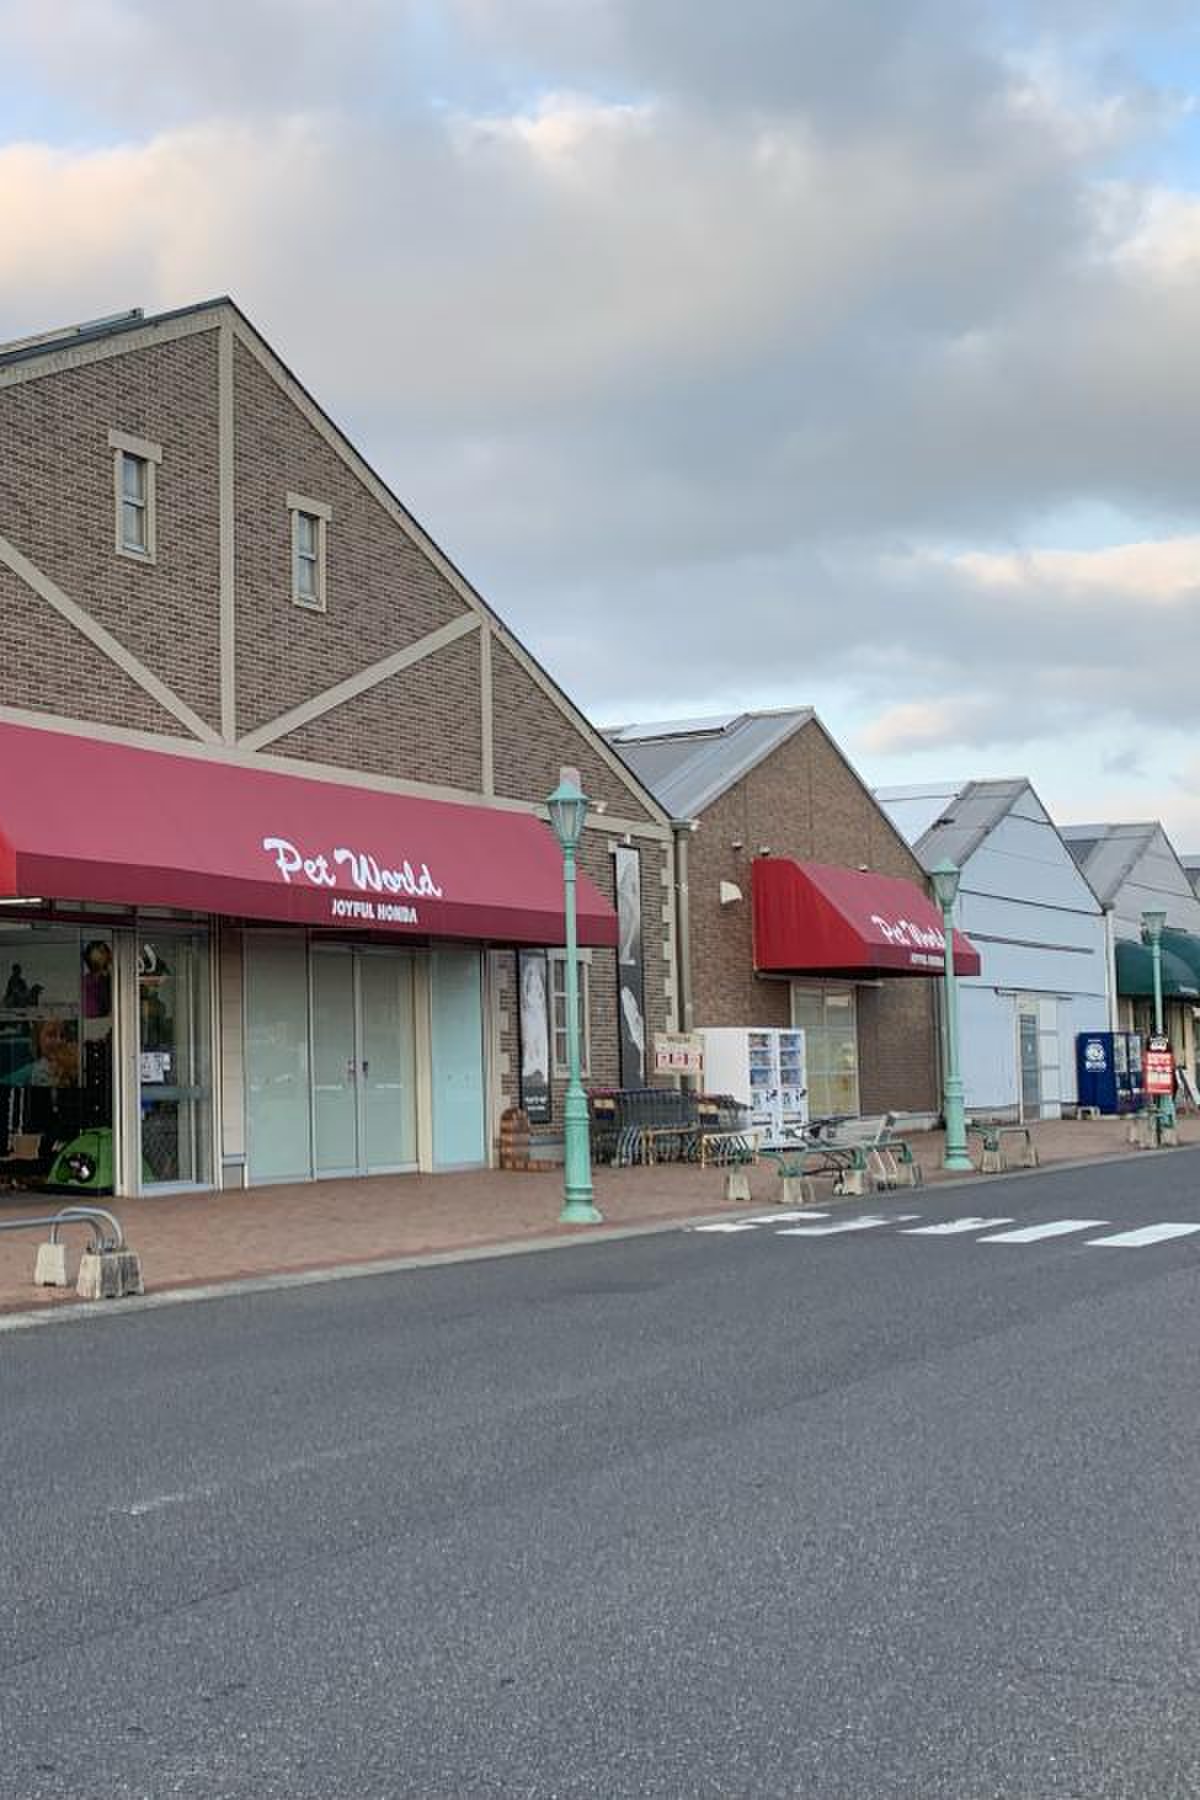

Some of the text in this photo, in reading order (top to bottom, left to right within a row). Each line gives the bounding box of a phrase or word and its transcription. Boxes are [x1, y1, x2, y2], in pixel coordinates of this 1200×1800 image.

[263, 837, 442, 897] Pet World
[332, 899, 418, 923] JOYFUL HONDA
